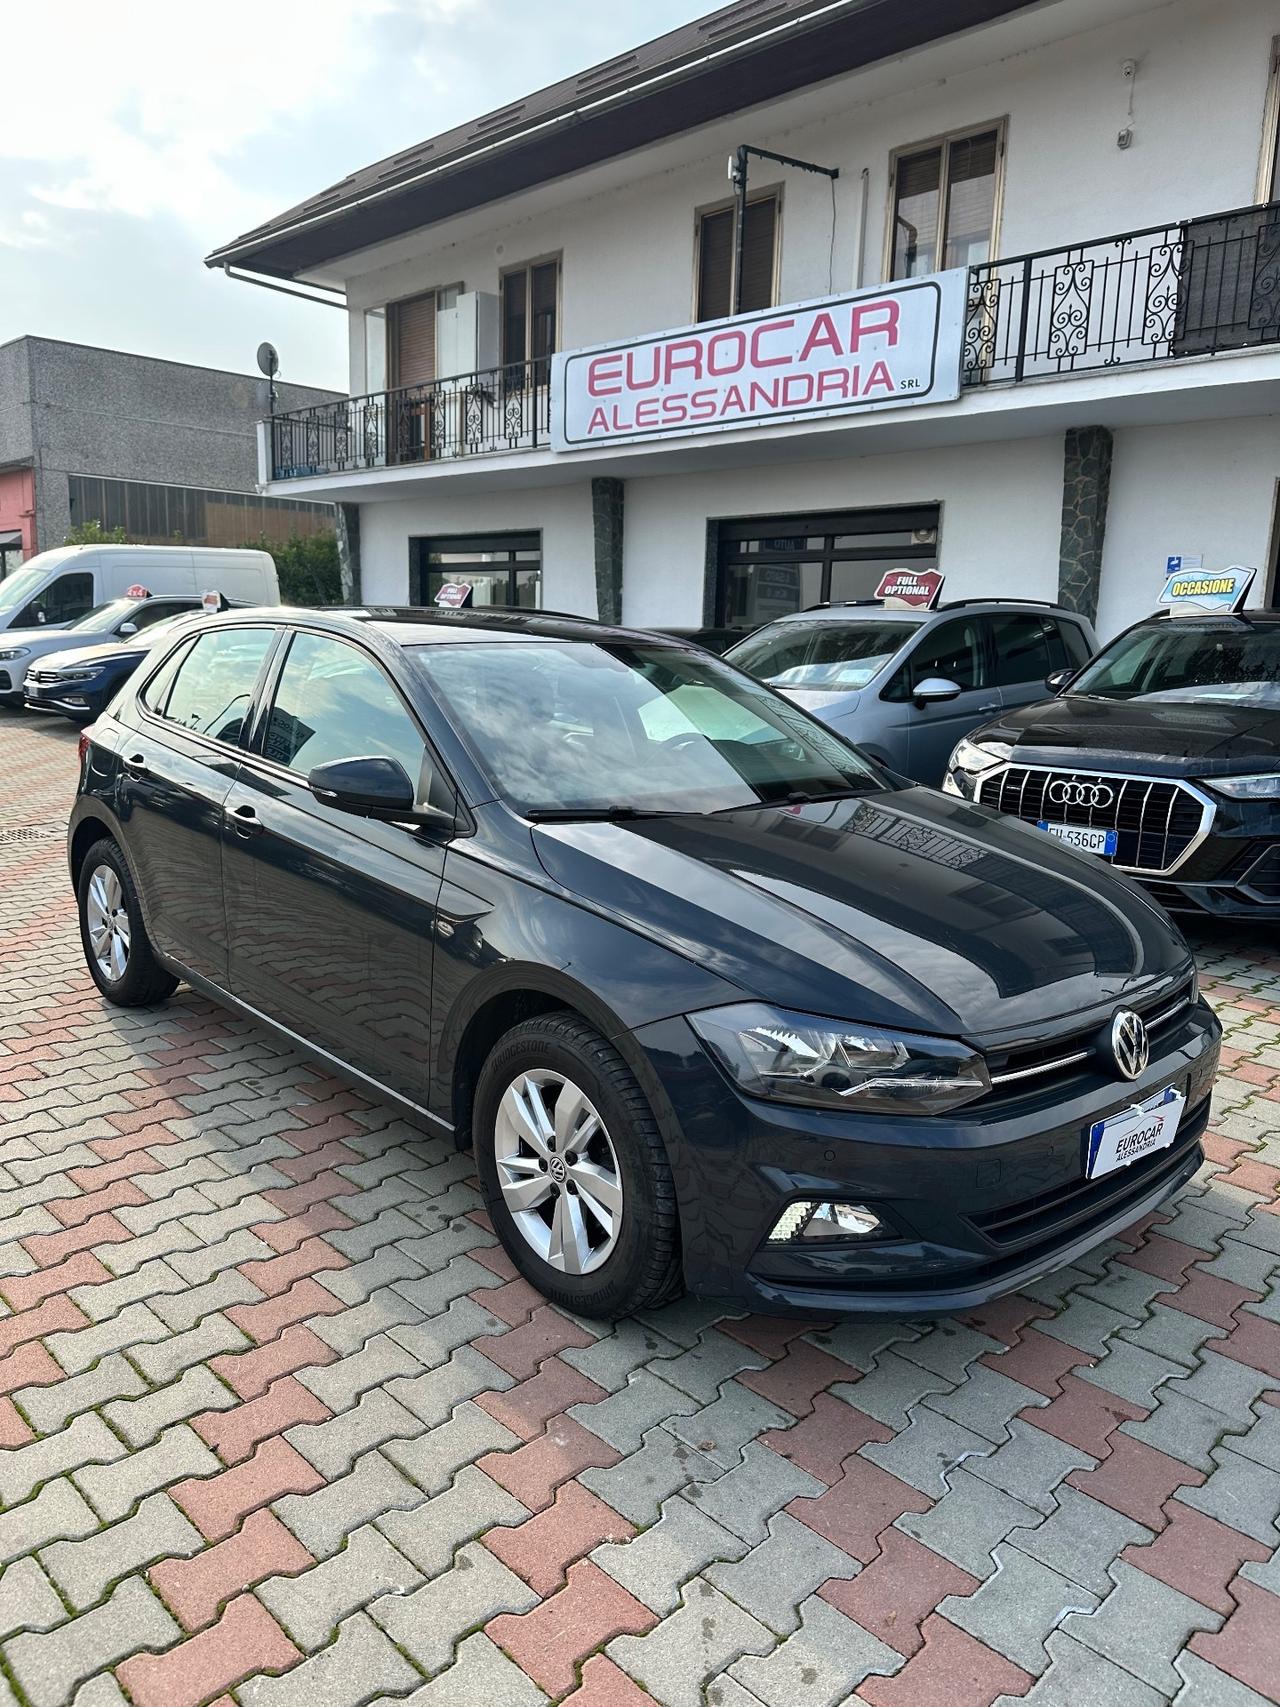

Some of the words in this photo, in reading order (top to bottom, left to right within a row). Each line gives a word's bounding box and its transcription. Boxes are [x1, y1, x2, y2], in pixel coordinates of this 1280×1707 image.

[588, 300, 900, 397] EUROCAR
[587, 361, 895, 434] ALESSANDRIA
[900, 378, 921, 390] SRL
[884, 585, 930, 595] OPTIONAL
[896, 576, 918, 585] FULL
[1171, 578, 1235, 597] OCCASIONE
[1115, 1123, 1164, 1154] EUROCAR
